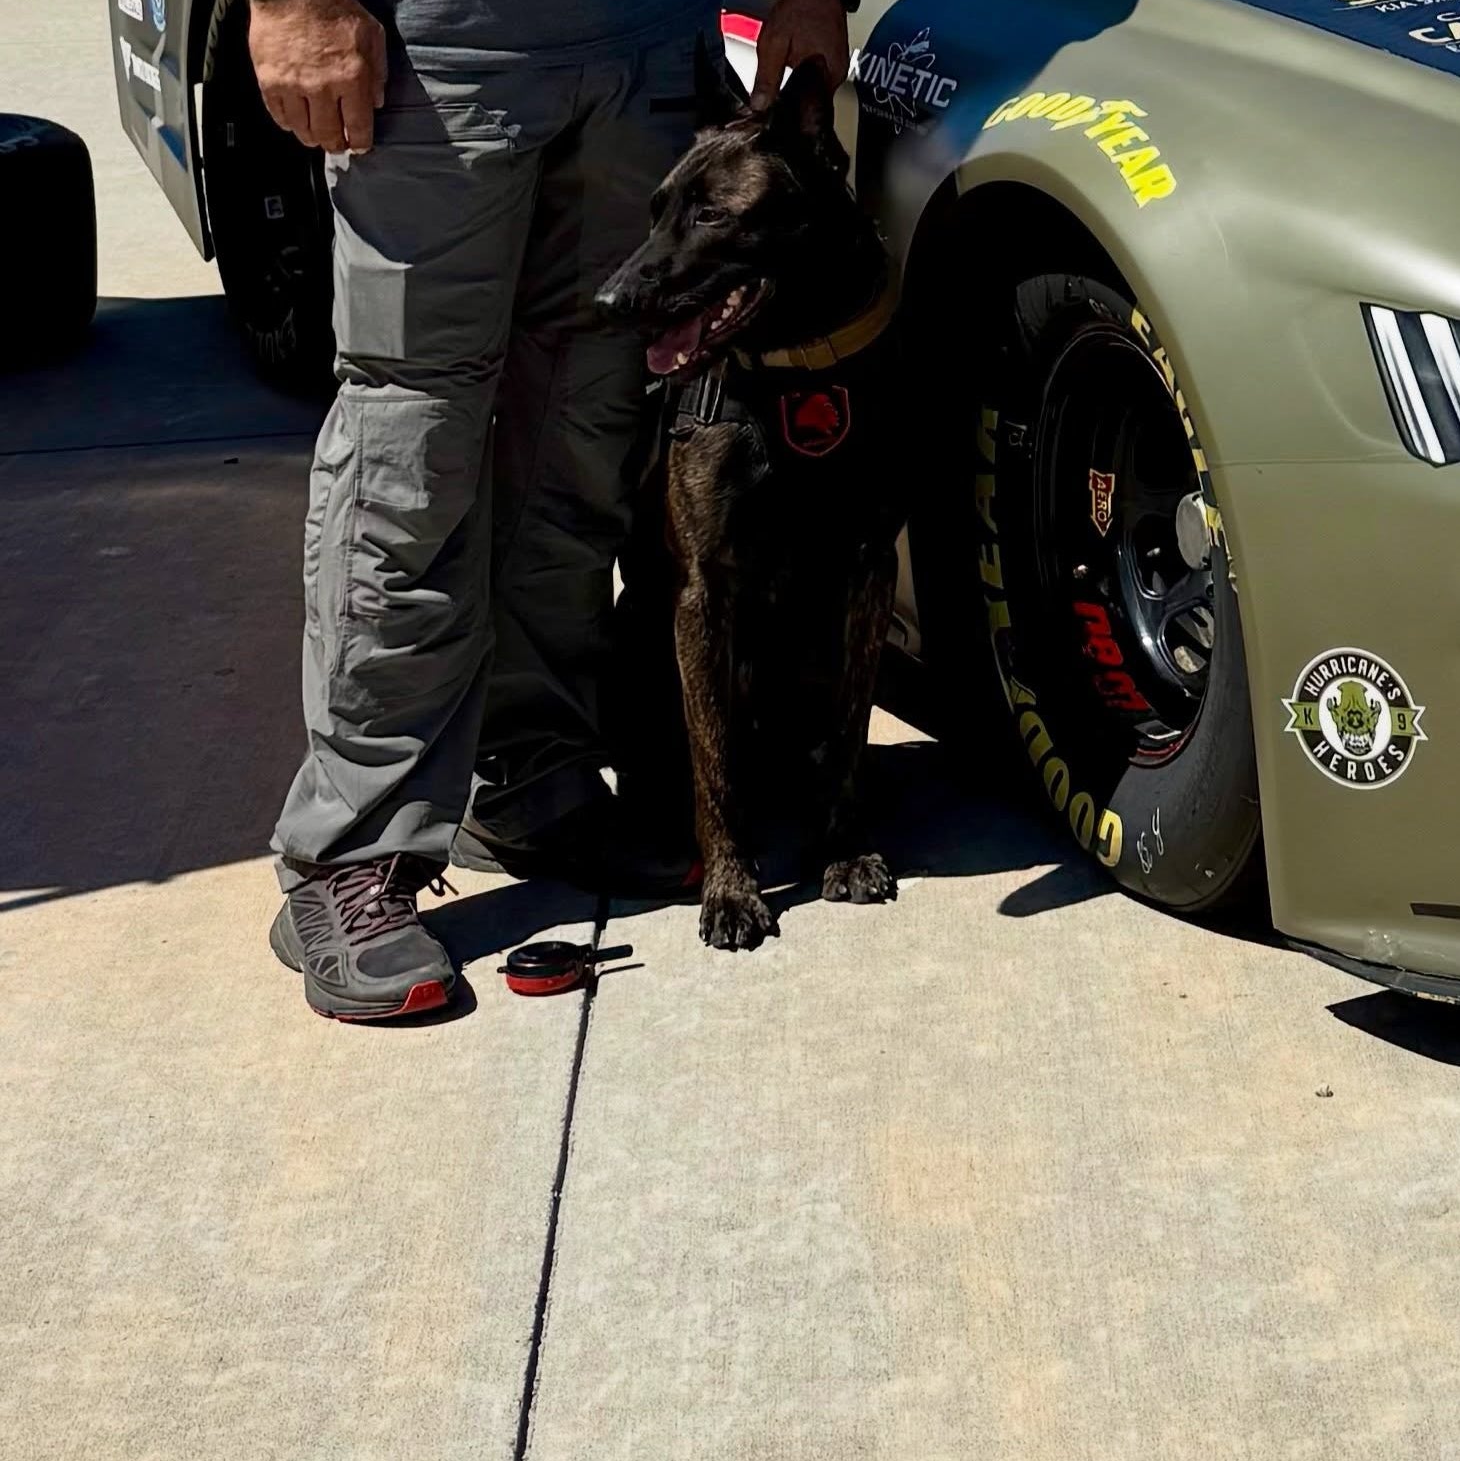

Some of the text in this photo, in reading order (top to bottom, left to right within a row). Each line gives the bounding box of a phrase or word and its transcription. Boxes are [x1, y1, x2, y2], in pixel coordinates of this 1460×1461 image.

[847, 48, 958, 108] KINETIC
[983, 91, 1178, 209] GOODYEAR
[1096, 476, 1108, 522] AERO
[1304, 656, 1401, 701] HURRICANE'S
[1303, 707, 1407, 730] K 9
[1313, 740, 1405, 781] HEROES
